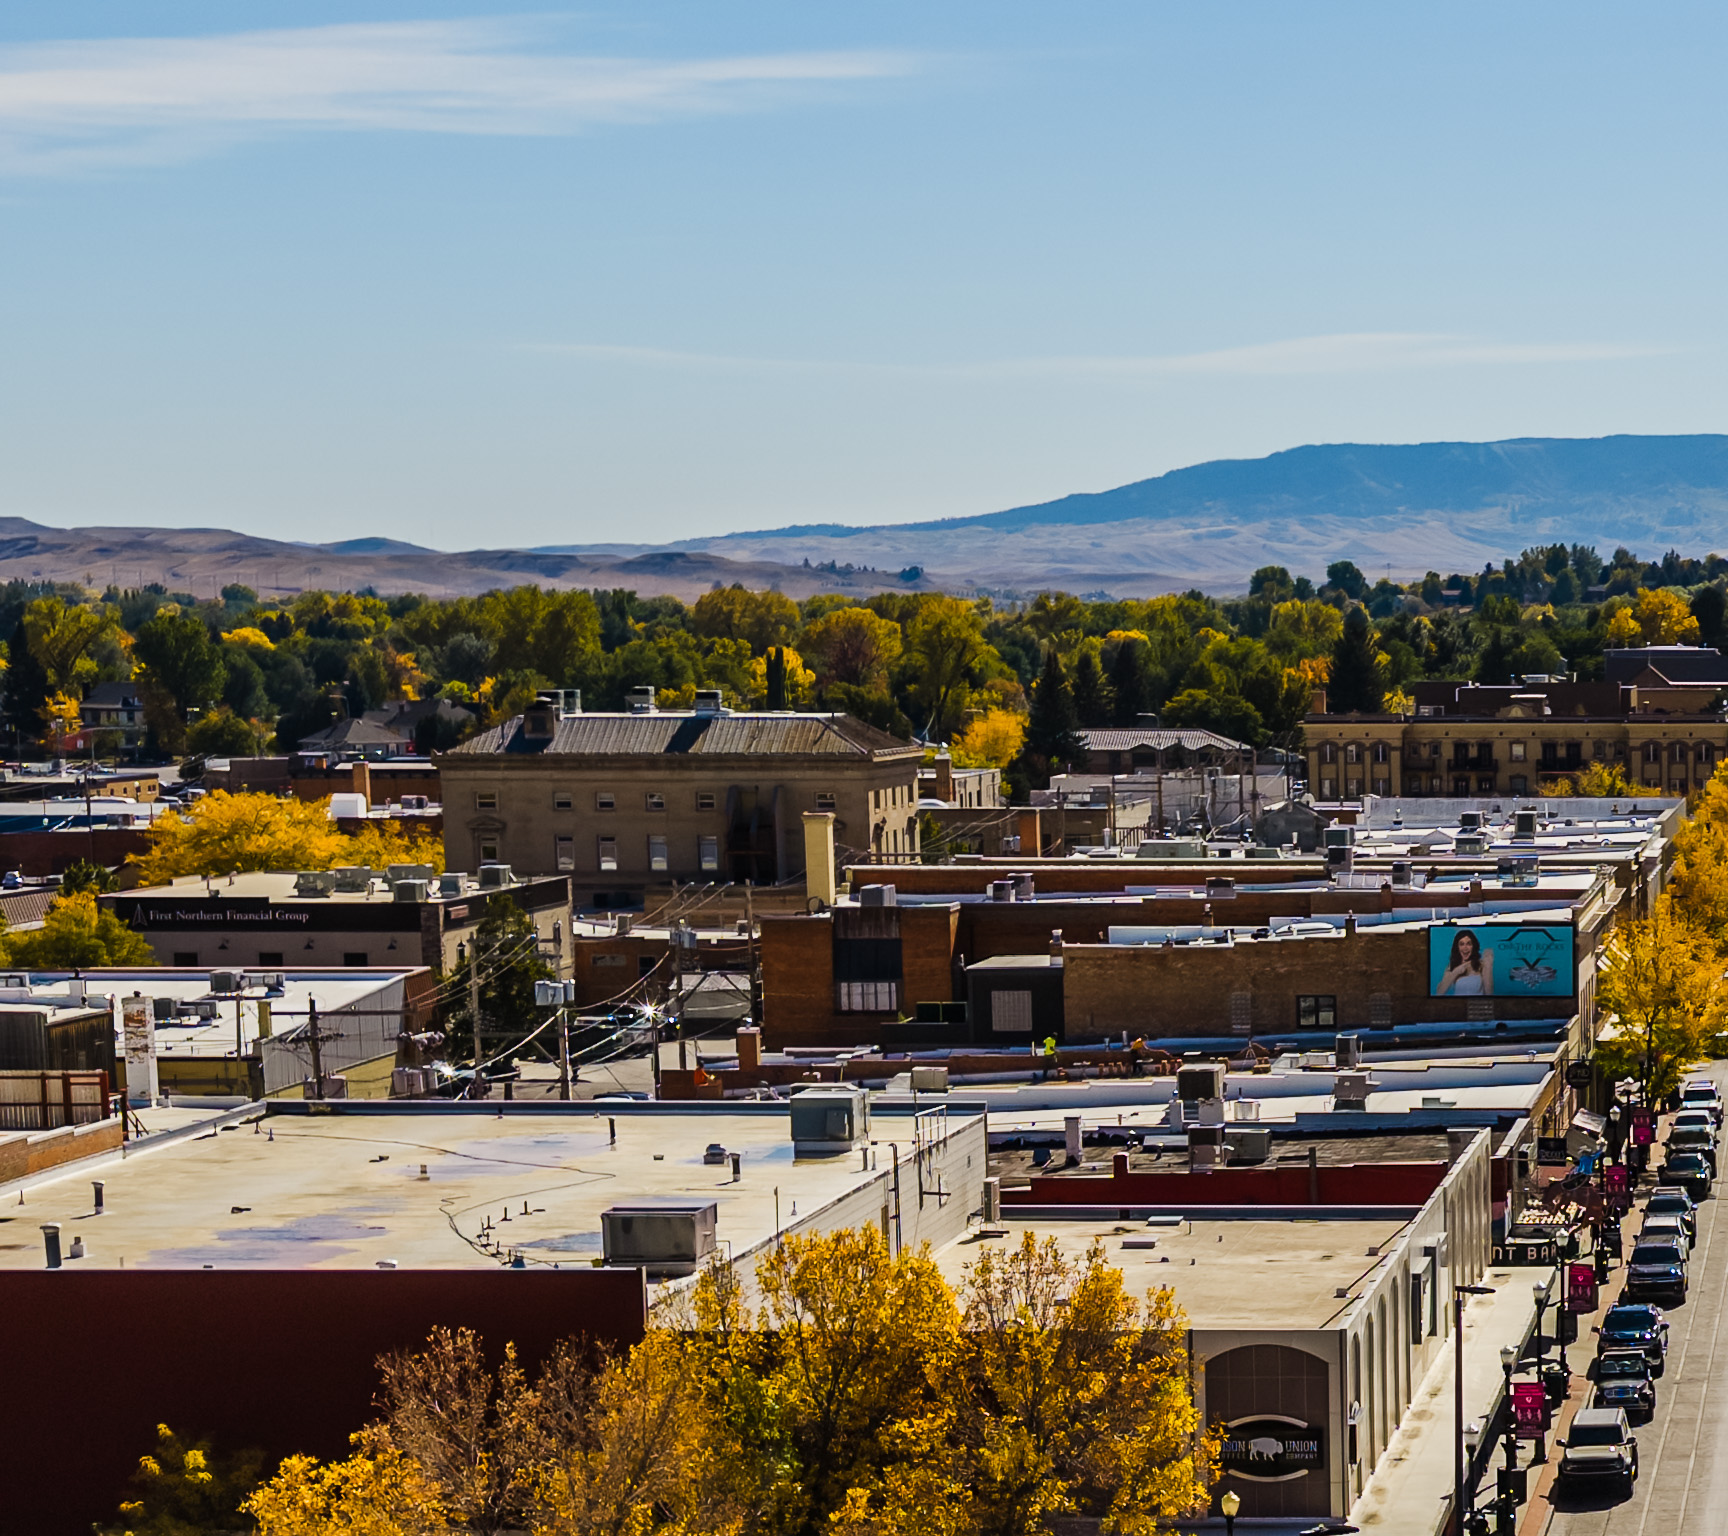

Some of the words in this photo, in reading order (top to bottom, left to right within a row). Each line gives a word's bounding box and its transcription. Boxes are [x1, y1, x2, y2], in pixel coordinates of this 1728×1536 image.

[150, 910, 172, 920] First
[176, 910, 223, 920] Northern
[227, 910, 273, 920] Financial
[276, 910, 309, 923] Group
[1492, 1246, 1517, 1261] NT
[1527, 1244, 1557, 1260] BAR
[1221, 1440, 1246, 1452] ISON
[1285, 1440, 1318, 1452] UNION
